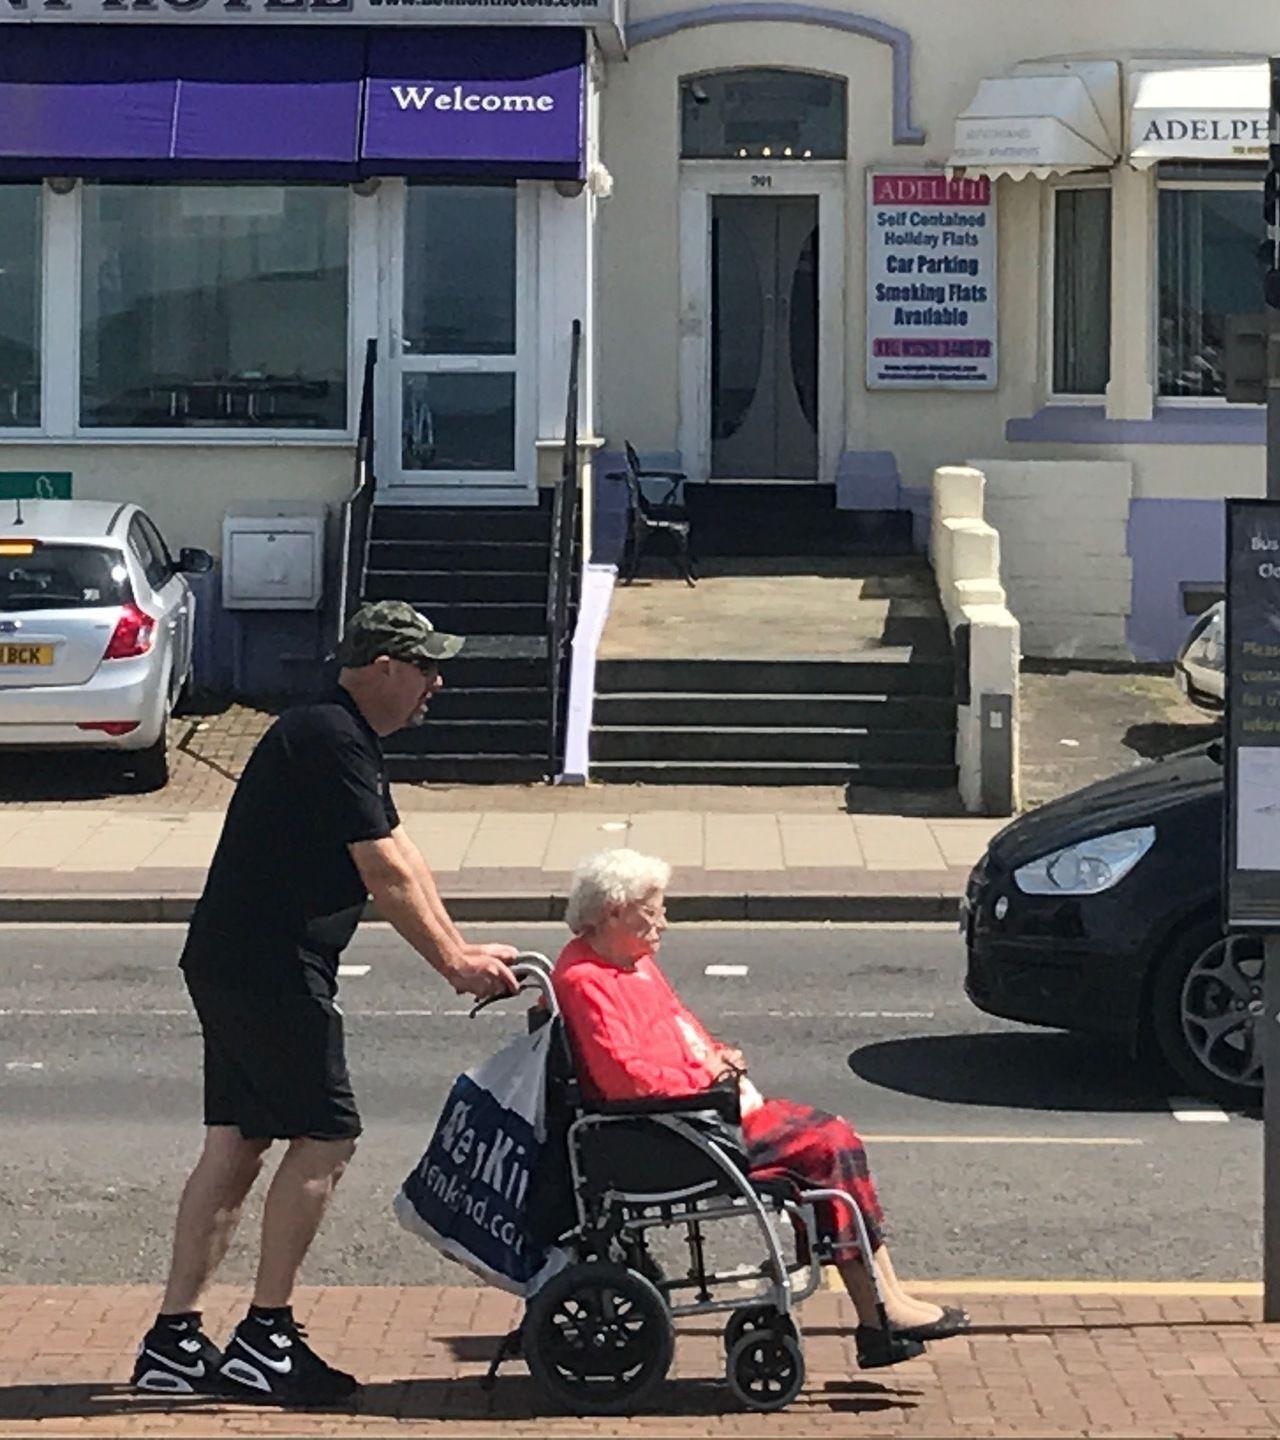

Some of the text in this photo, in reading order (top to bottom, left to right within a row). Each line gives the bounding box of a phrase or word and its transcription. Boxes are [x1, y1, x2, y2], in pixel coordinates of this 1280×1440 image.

[390, 85, 555, 113] Welcome
[1142, 119, 1270, 141] ADELPH
[878, 178, 987, 201] ADELPHI
[877, 211, 986, 228] Self Contained
[884, 231, 979, 248] Holiday Flats
[886, 254, 979, 276] Car Parking
[875, 282, 988, 304] Smoking Flats
[893, 307, 969, 327] Available
[1250, 536, 1279, 552] Bus
[6, 646, 40, 664] BCK
